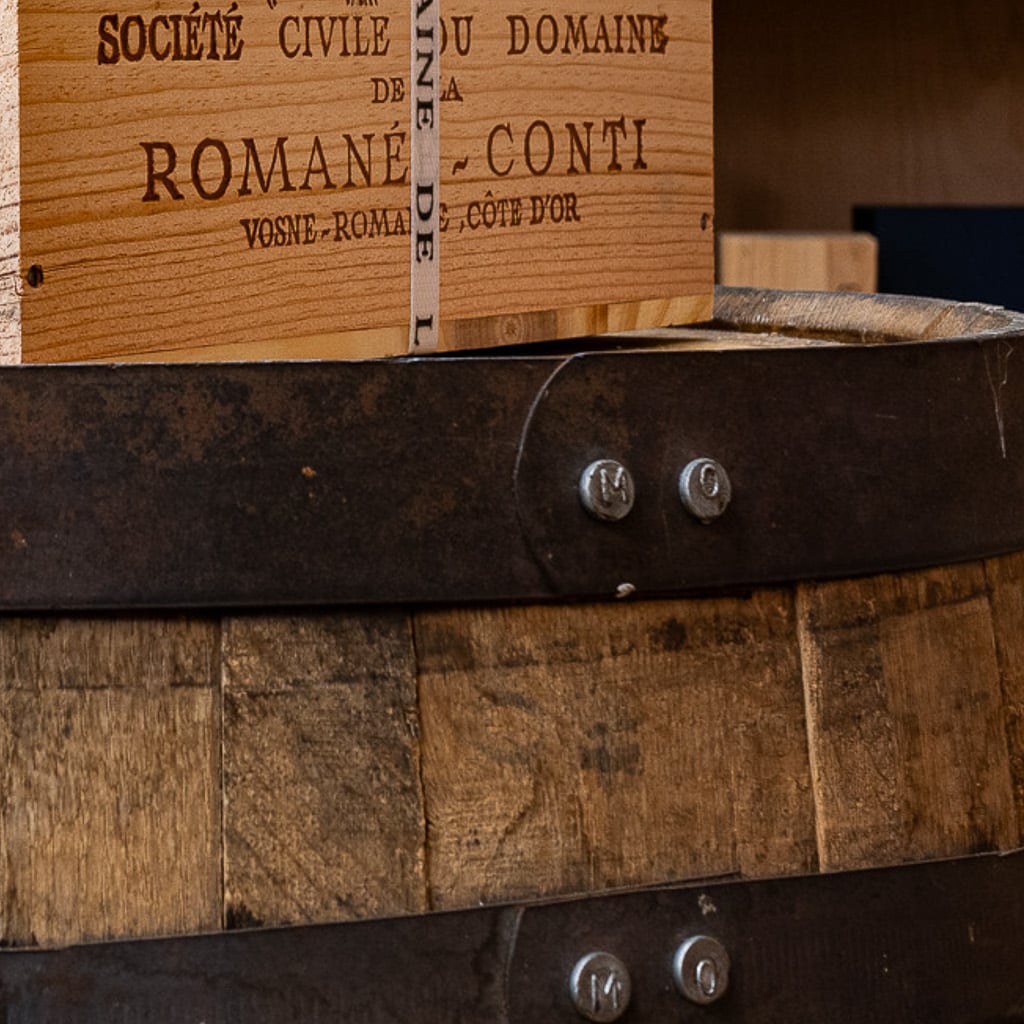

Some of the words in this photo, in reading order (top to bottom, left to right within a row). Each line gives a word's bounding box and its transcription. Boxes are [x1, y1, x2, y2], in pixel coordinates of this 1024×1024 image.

[97, 1, 245, 65] SOCIÉTÉ
[278, 14, 390, 58] CIVILE
[506, 13, 670, 56] DOMAINE
[371, 76, 405, 104] DE
[415, 182, 435, 263] DE
[529, 191, 582, 226] D'OR
